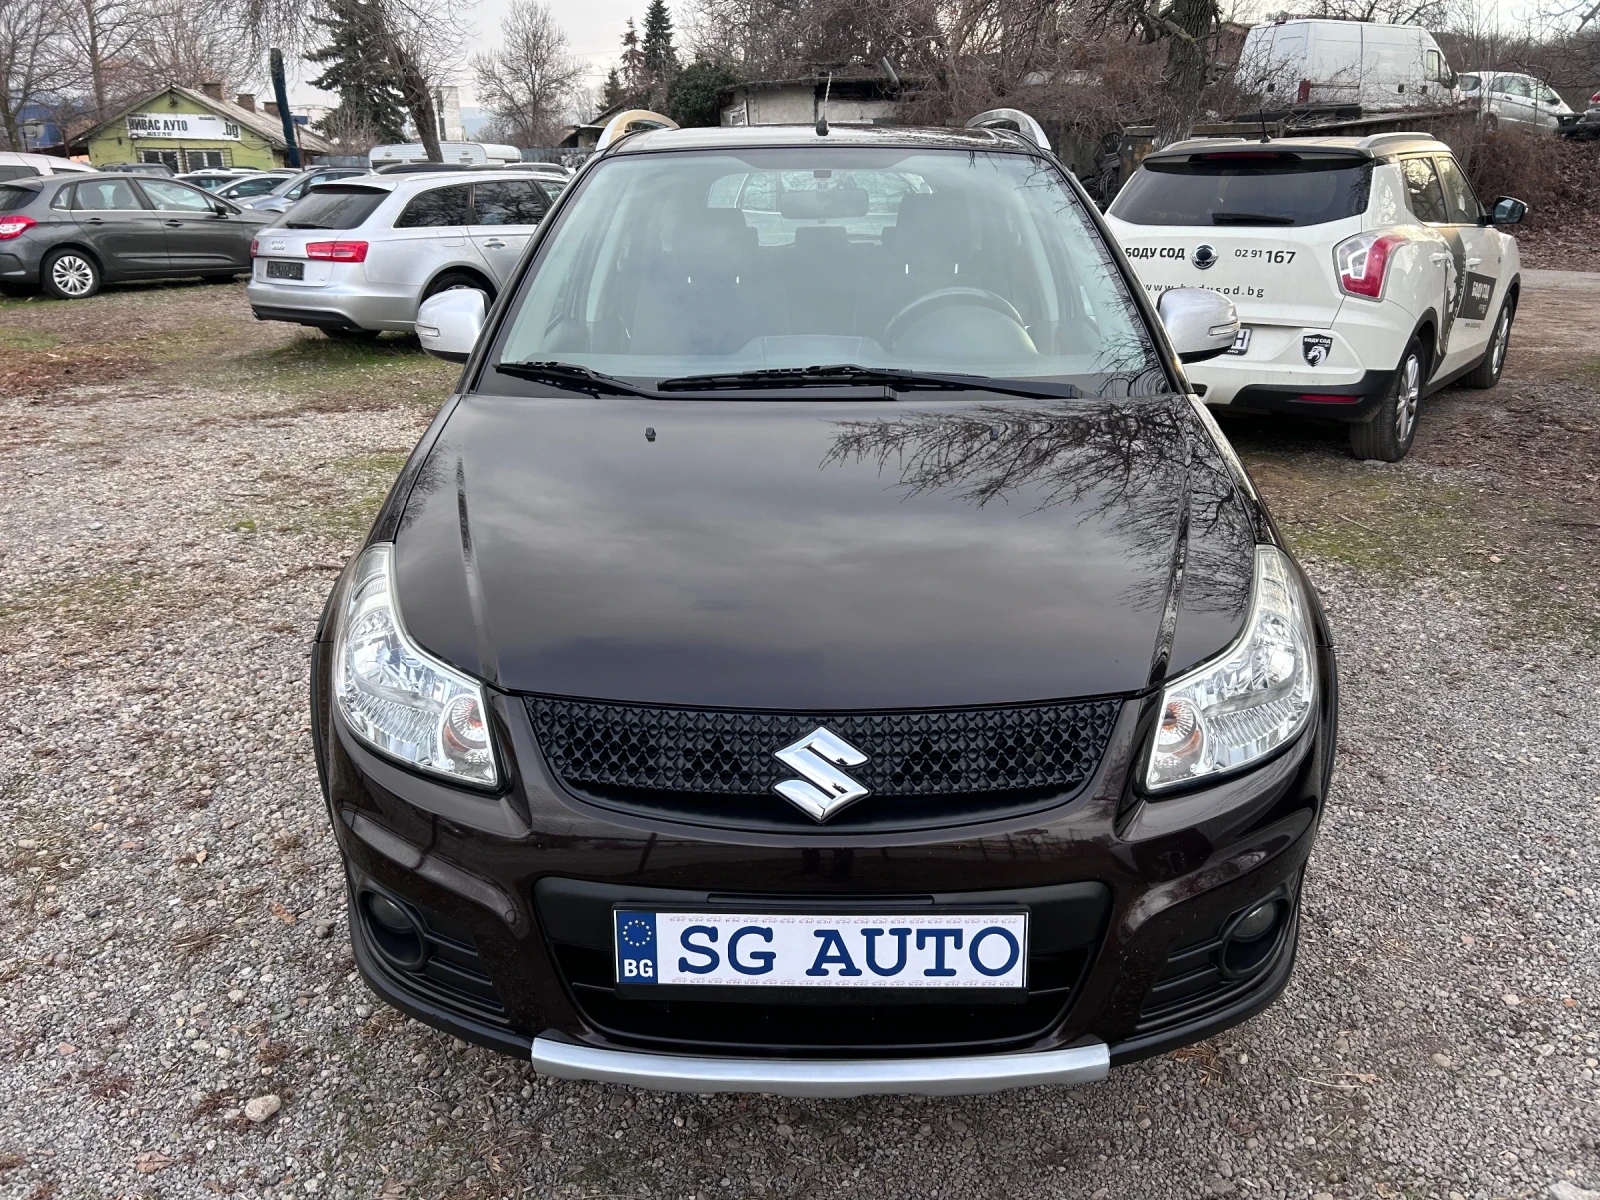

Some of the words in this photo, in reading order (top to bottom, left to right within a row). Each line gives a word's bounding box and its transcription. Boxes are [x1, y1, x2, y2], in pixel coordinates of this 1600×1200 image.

[163, 120, 188, 131] АУТО
[222, 121, 239, 138] .bg
[1125, 247, 1157, 259] БОДУ
[1159, 247, 1185, 260] СОД
[1234, 249, 1248, 257] 02
[1251, 249, 1263, 258] 91
[1265, 250, 1296, 264] 167
[1144, 283, 1265, 298] wwwsod.bg
[678, 925, 777, 976] SG
[805, 926, 1020, 977] AUTO
[623, 958, 653, 978] BG
